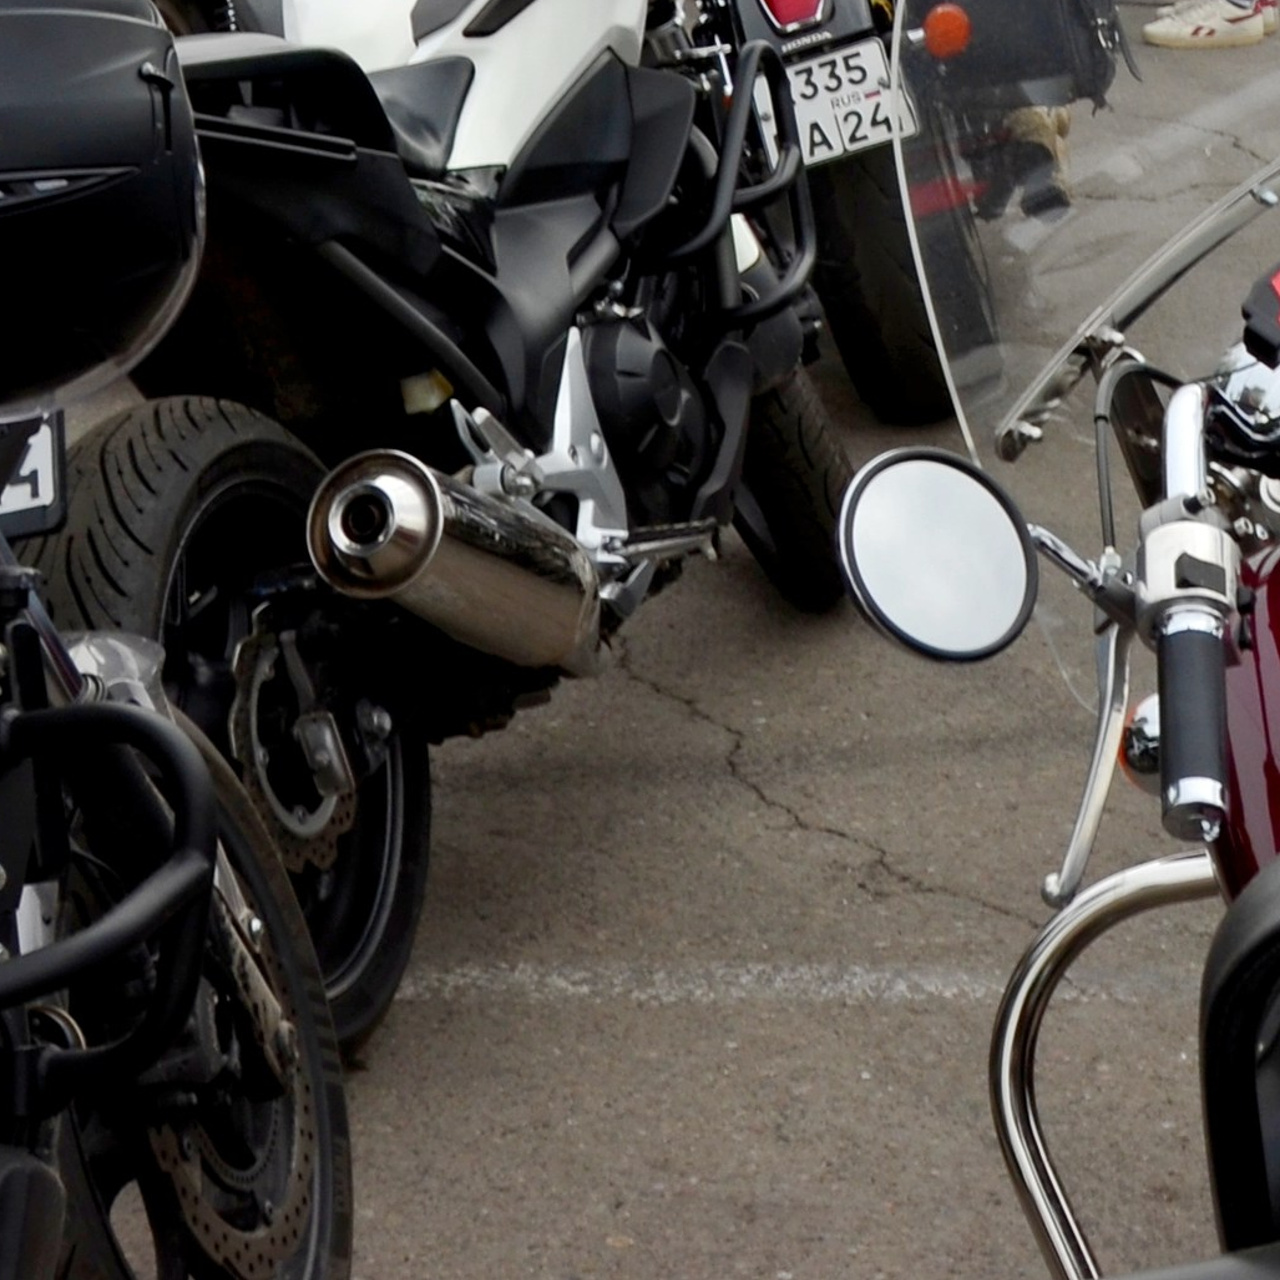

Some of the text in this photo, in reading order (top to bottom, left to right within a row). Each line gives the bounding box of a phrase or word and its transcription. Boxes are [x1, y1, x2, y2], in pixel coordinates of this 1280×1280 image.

[781, 30, 833, 53] HONDA
[793, 50, 868, 105] 335
[830, 92, 862, 111] RUS
[808, 101, 895, 158] A 24
